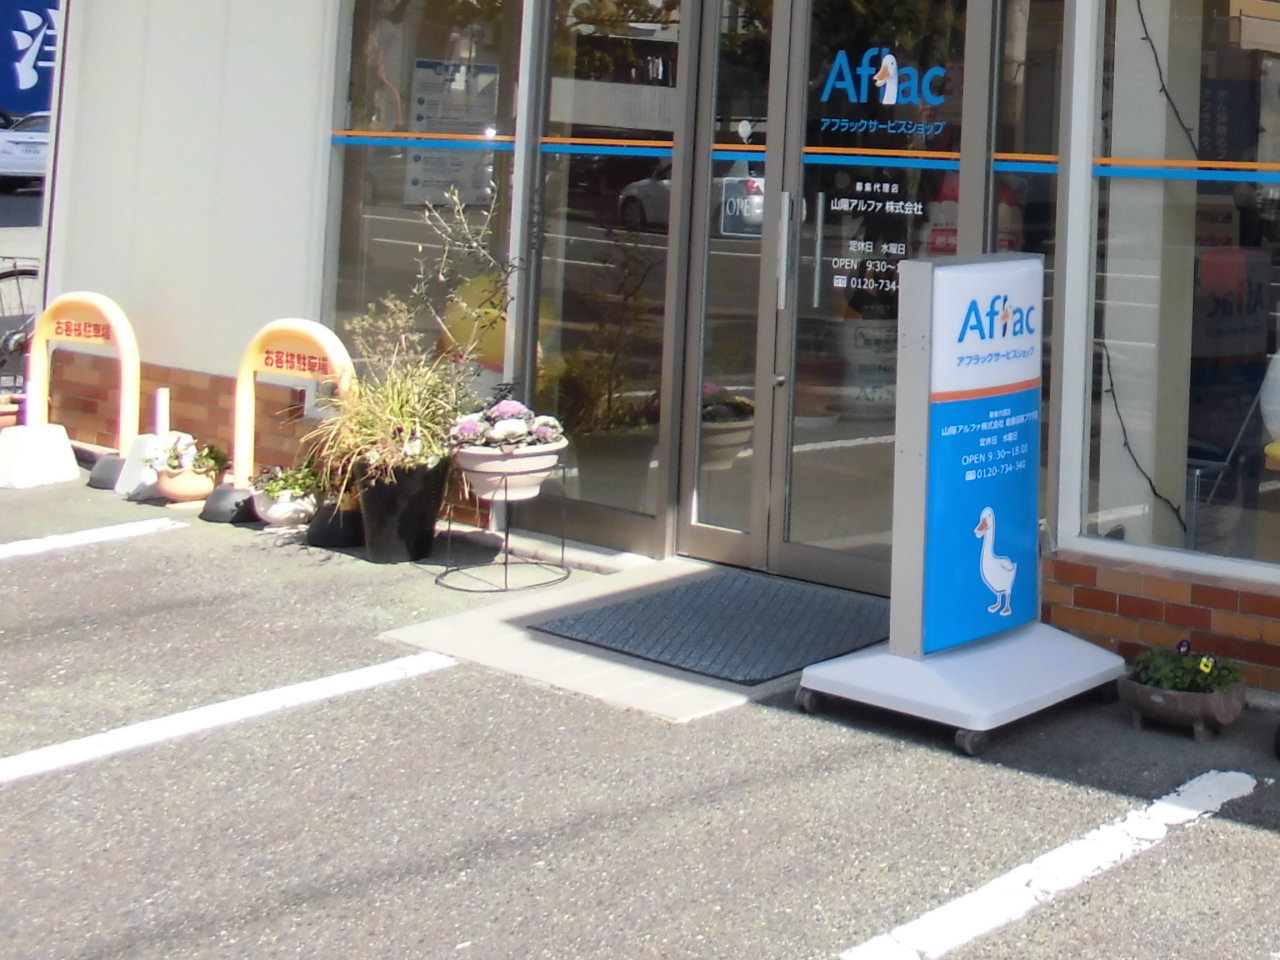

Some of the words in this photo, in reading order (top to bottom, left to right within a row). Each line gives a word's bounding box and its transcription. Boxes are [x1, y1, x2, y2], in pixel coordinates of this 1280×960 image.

[820, 118, 947, 135] アフラックサービスショップ
[726, 198, 761, 217] OPE
[849, 241, 873, 252] 定休日
[881, 243, 905, 254] 水曜日
[832, 258, 857, 270] OPEN
[55, 320, 112, 340] お客様駐車場
[264, 349, 330, 375] お客様駐車場
[962, 453, 986, 465] OPEN
